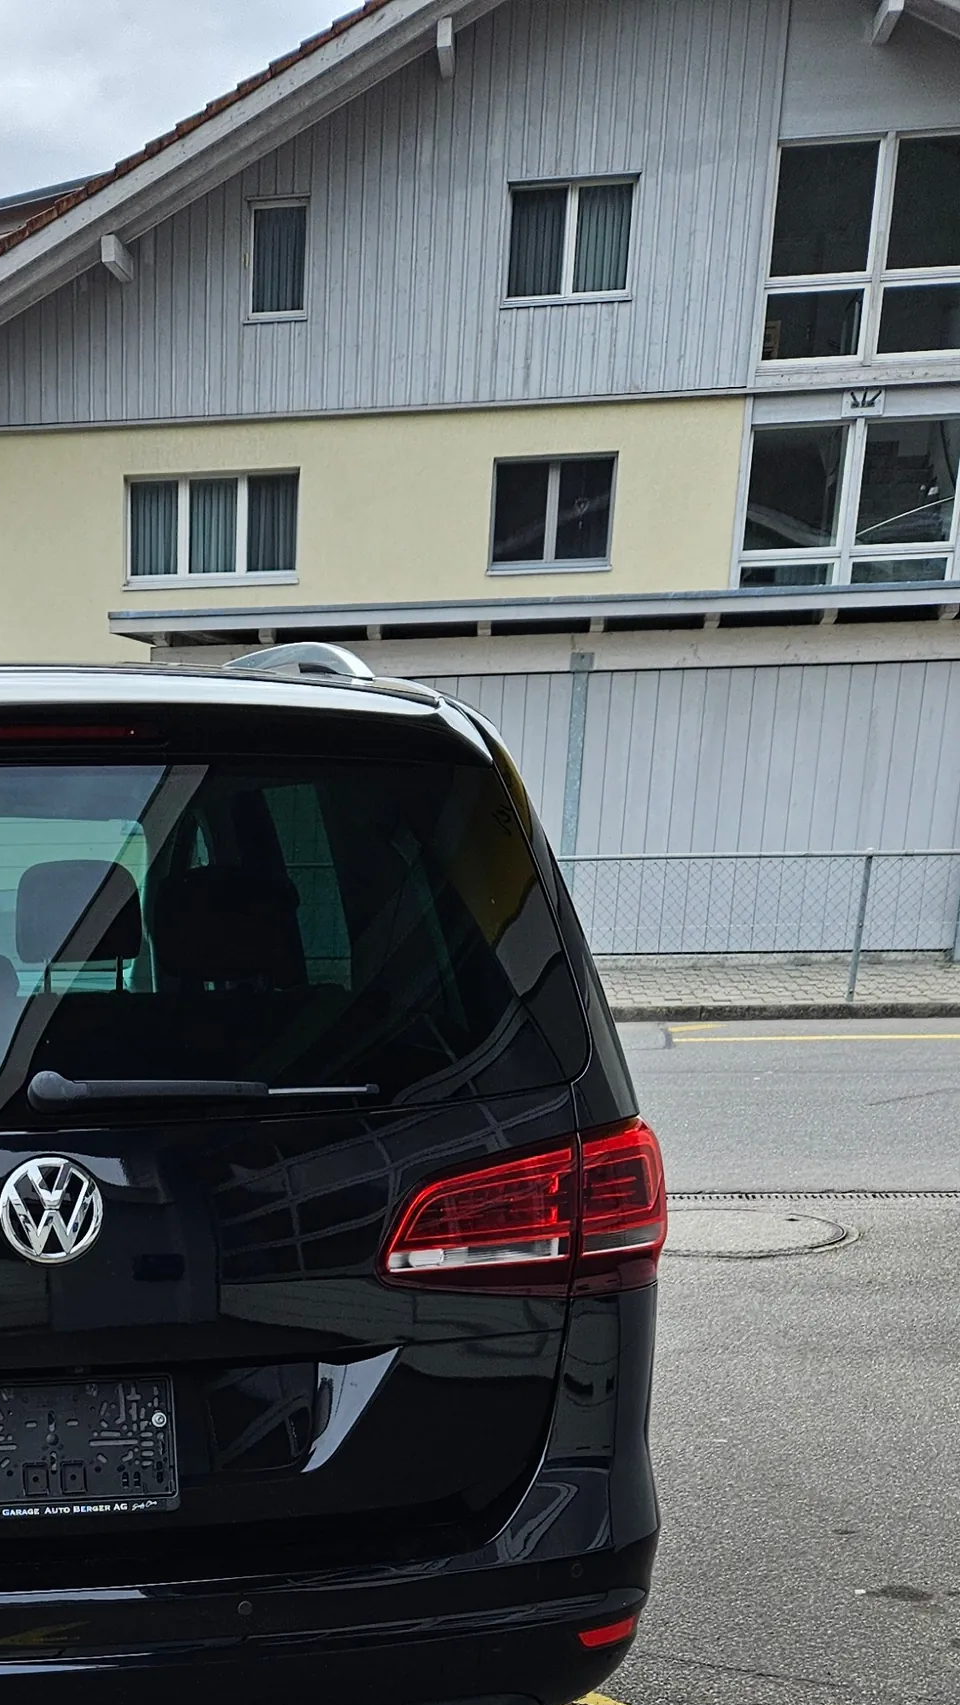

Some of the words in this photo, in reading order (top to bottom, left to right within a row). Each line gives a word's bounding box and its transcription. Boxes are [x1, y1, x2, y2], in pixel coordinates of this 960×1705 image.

[2, 1508, 40, 1516] GARAGE
[44, 1506, 71, 1515] AUTO
[73, 1505, 111, 1513] BERGER
[113, 1503, 128, 1511] AG
